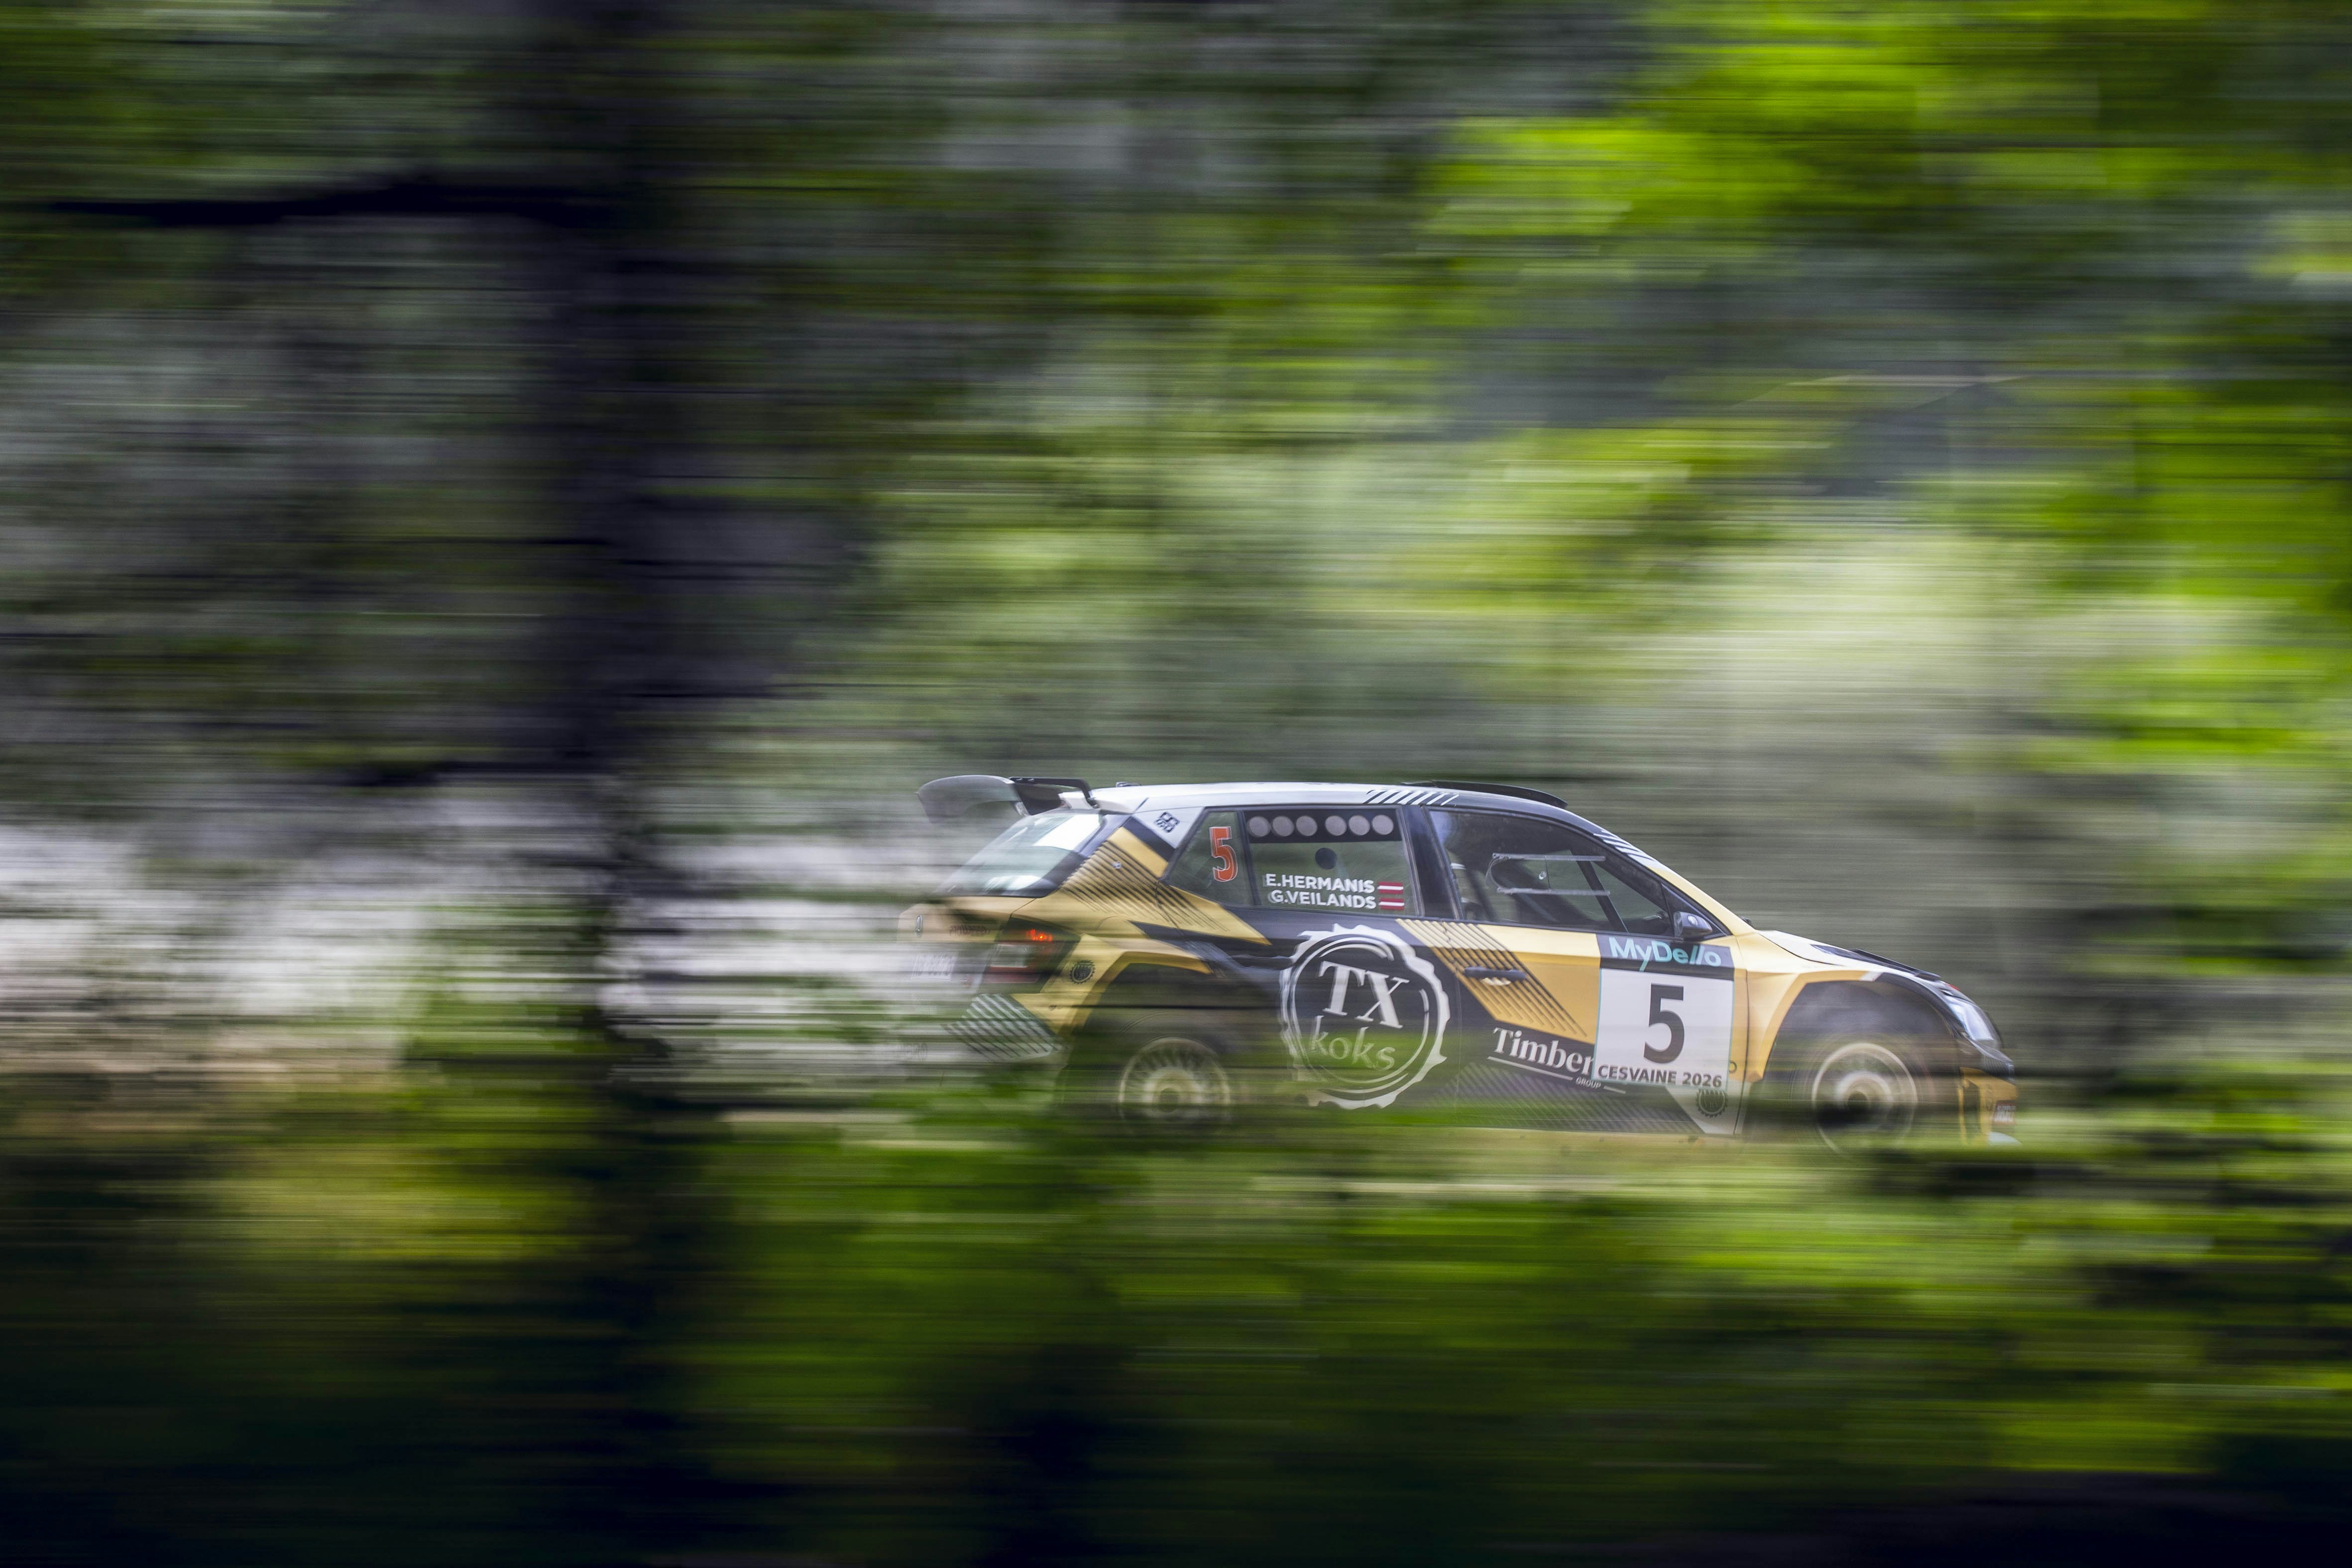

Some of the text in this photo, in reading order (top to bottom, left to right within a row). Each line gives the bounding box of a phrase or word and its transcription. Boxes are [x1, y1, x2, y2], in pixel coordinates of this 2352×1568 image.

[1210, 826, 1238, 882] 5
[1264, 873, 1375, 894] E.HERMANIS
[1269, 890, 1376, 909] G.VEILANDS
[1608, 936, 1721, 972] MyDello
[1319, 960, 1410, 1029] TX
[1644, 983, 1684, 1064] 5
[1310, 1015, 1395, 1070] koks
[1575, 1077, 1601, 1089] GROUP
[1598, 1065, 1722, 1088] CESVAINE 2026
